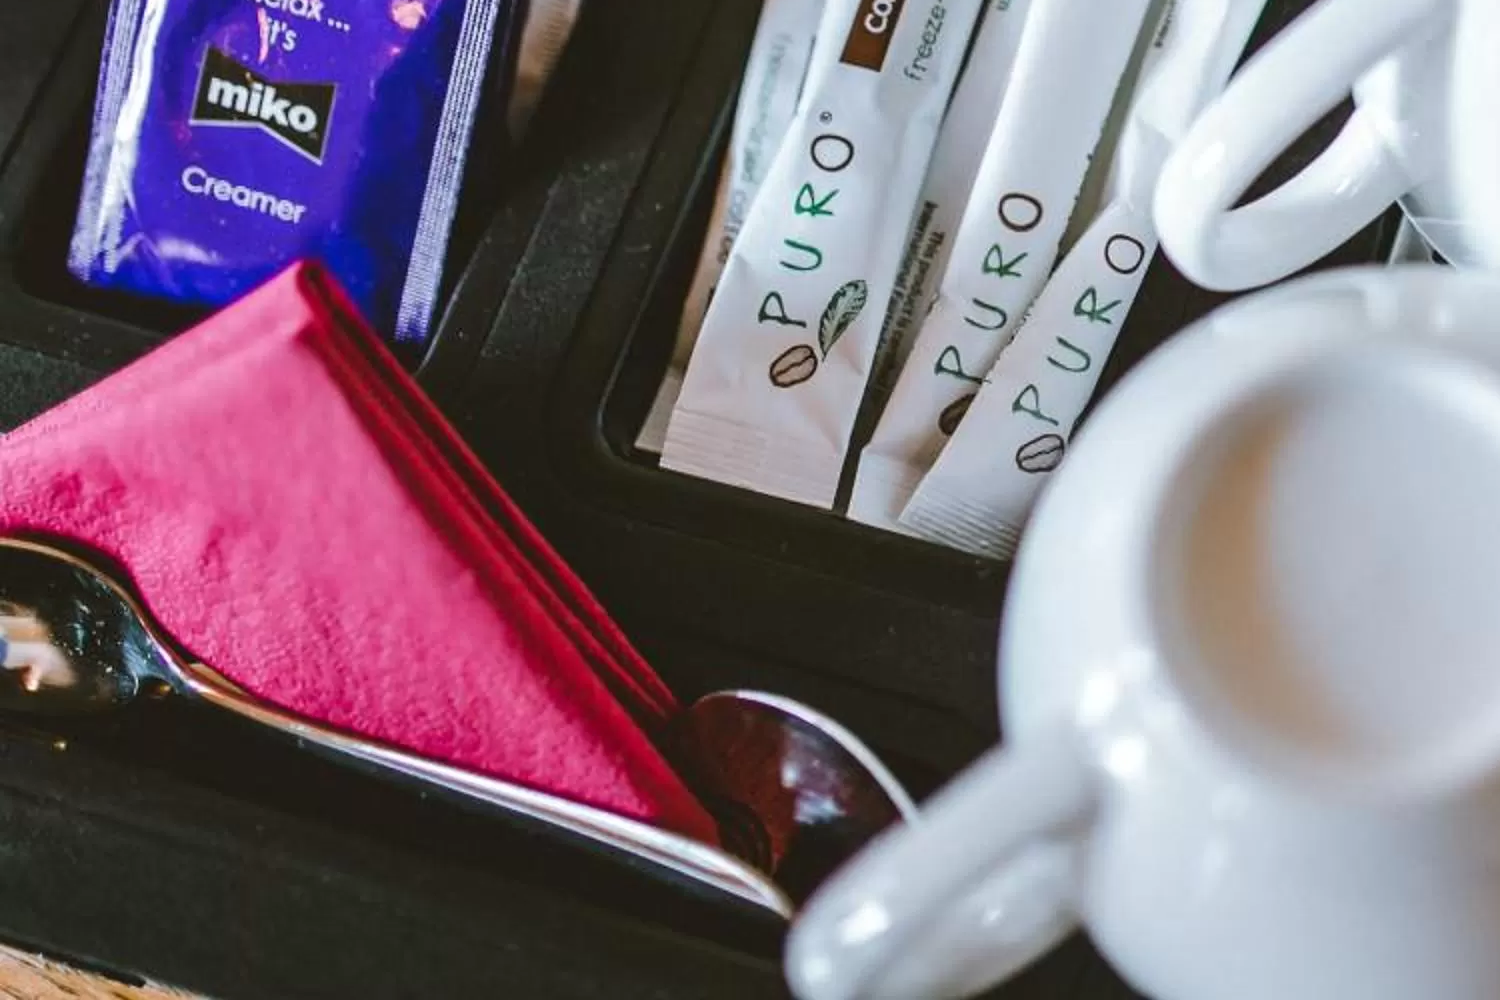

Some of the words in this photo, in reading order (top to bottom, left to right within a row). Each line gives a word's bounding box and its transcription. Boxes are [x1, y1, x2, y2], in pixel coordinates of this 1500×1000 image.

[181, 165, 306, 225] Creamer
[207, 76, 318, 133] miko
[759, 133, 855, 330] PURO
[934, 192, 1043, 385] PURO
[1012, 233, 1146, 426] PURO
